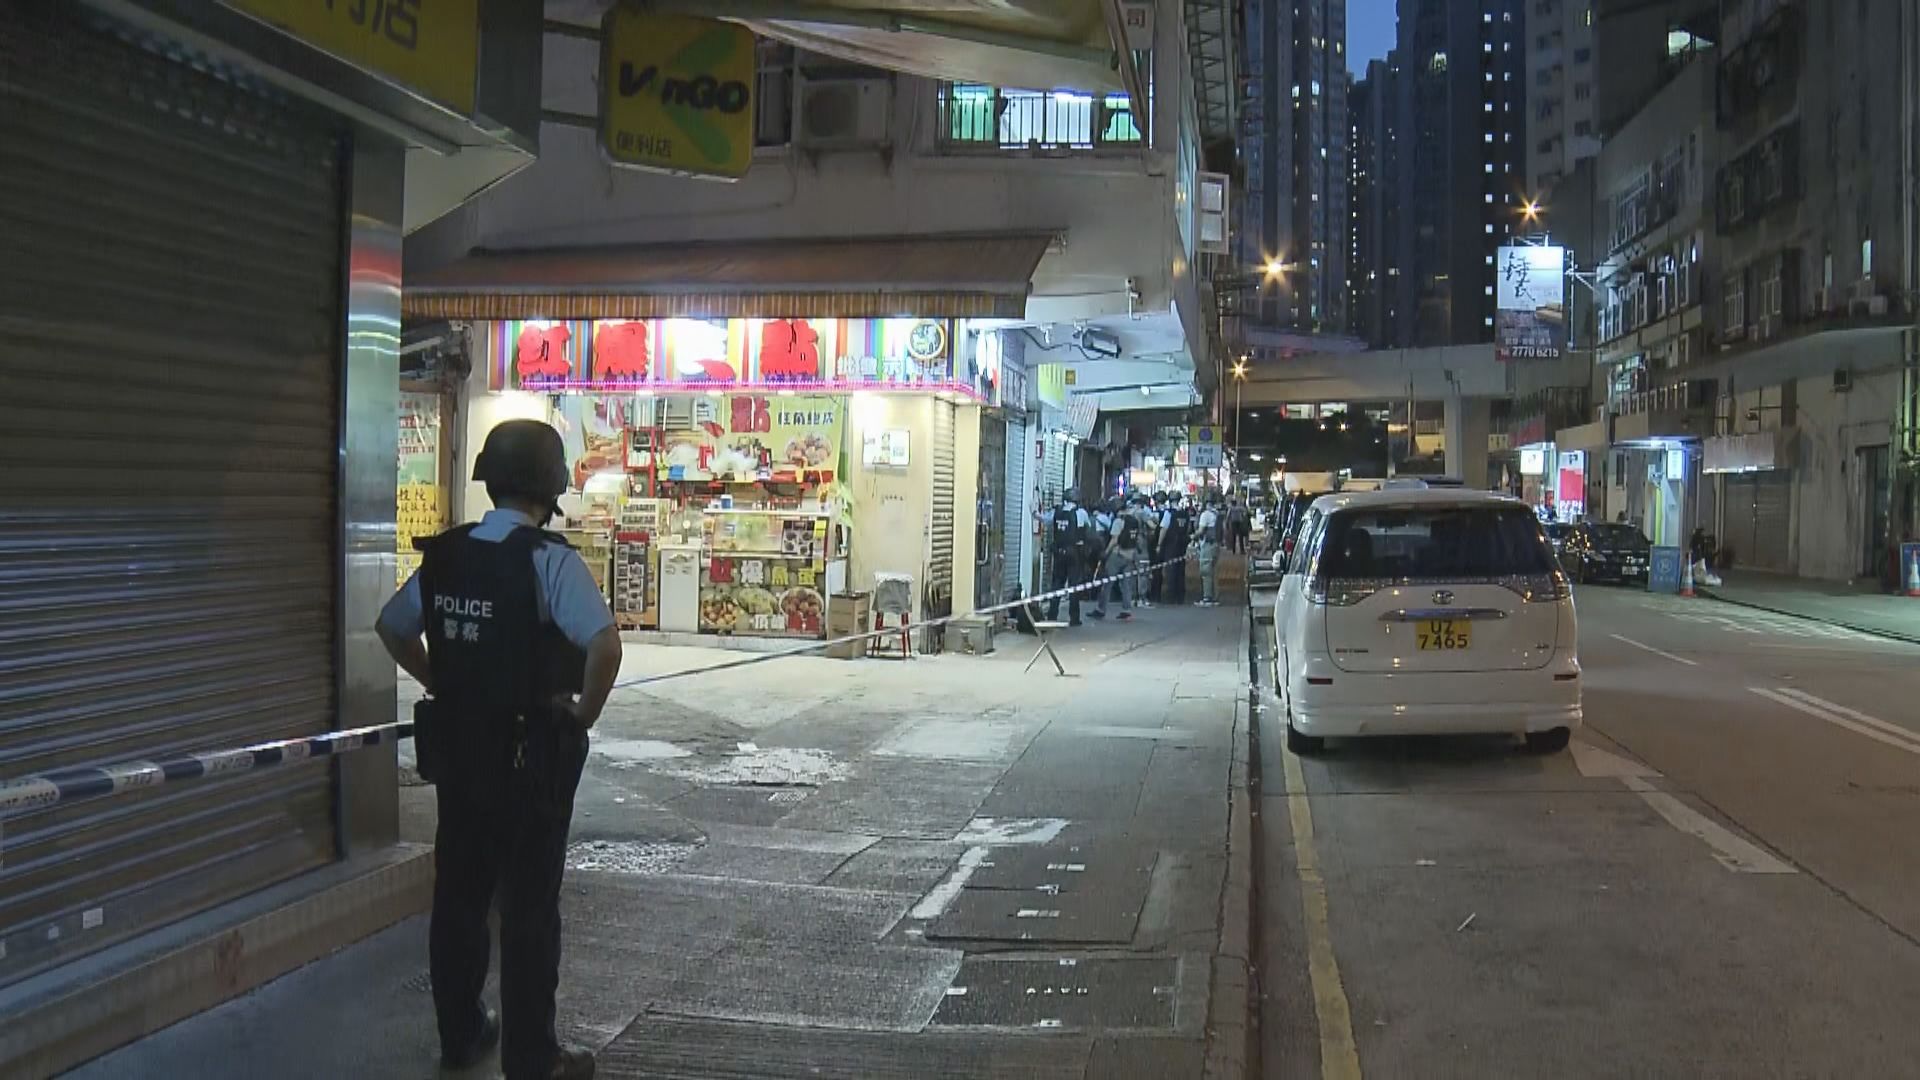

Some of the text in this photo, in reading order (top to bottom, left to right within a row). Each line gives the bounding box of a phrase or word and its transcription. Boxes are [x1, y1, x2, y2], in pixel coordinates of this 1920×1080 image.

[616, 130, 672, 158] 便利店
[1512, 346, 1535, 358] 2770
[434, 594, 493, 617] POLICE
[443, 618, 480, 641] 警察
[1430, 619, 1455, 636] UZ
[1418, 634, 1468, 649] 7465
